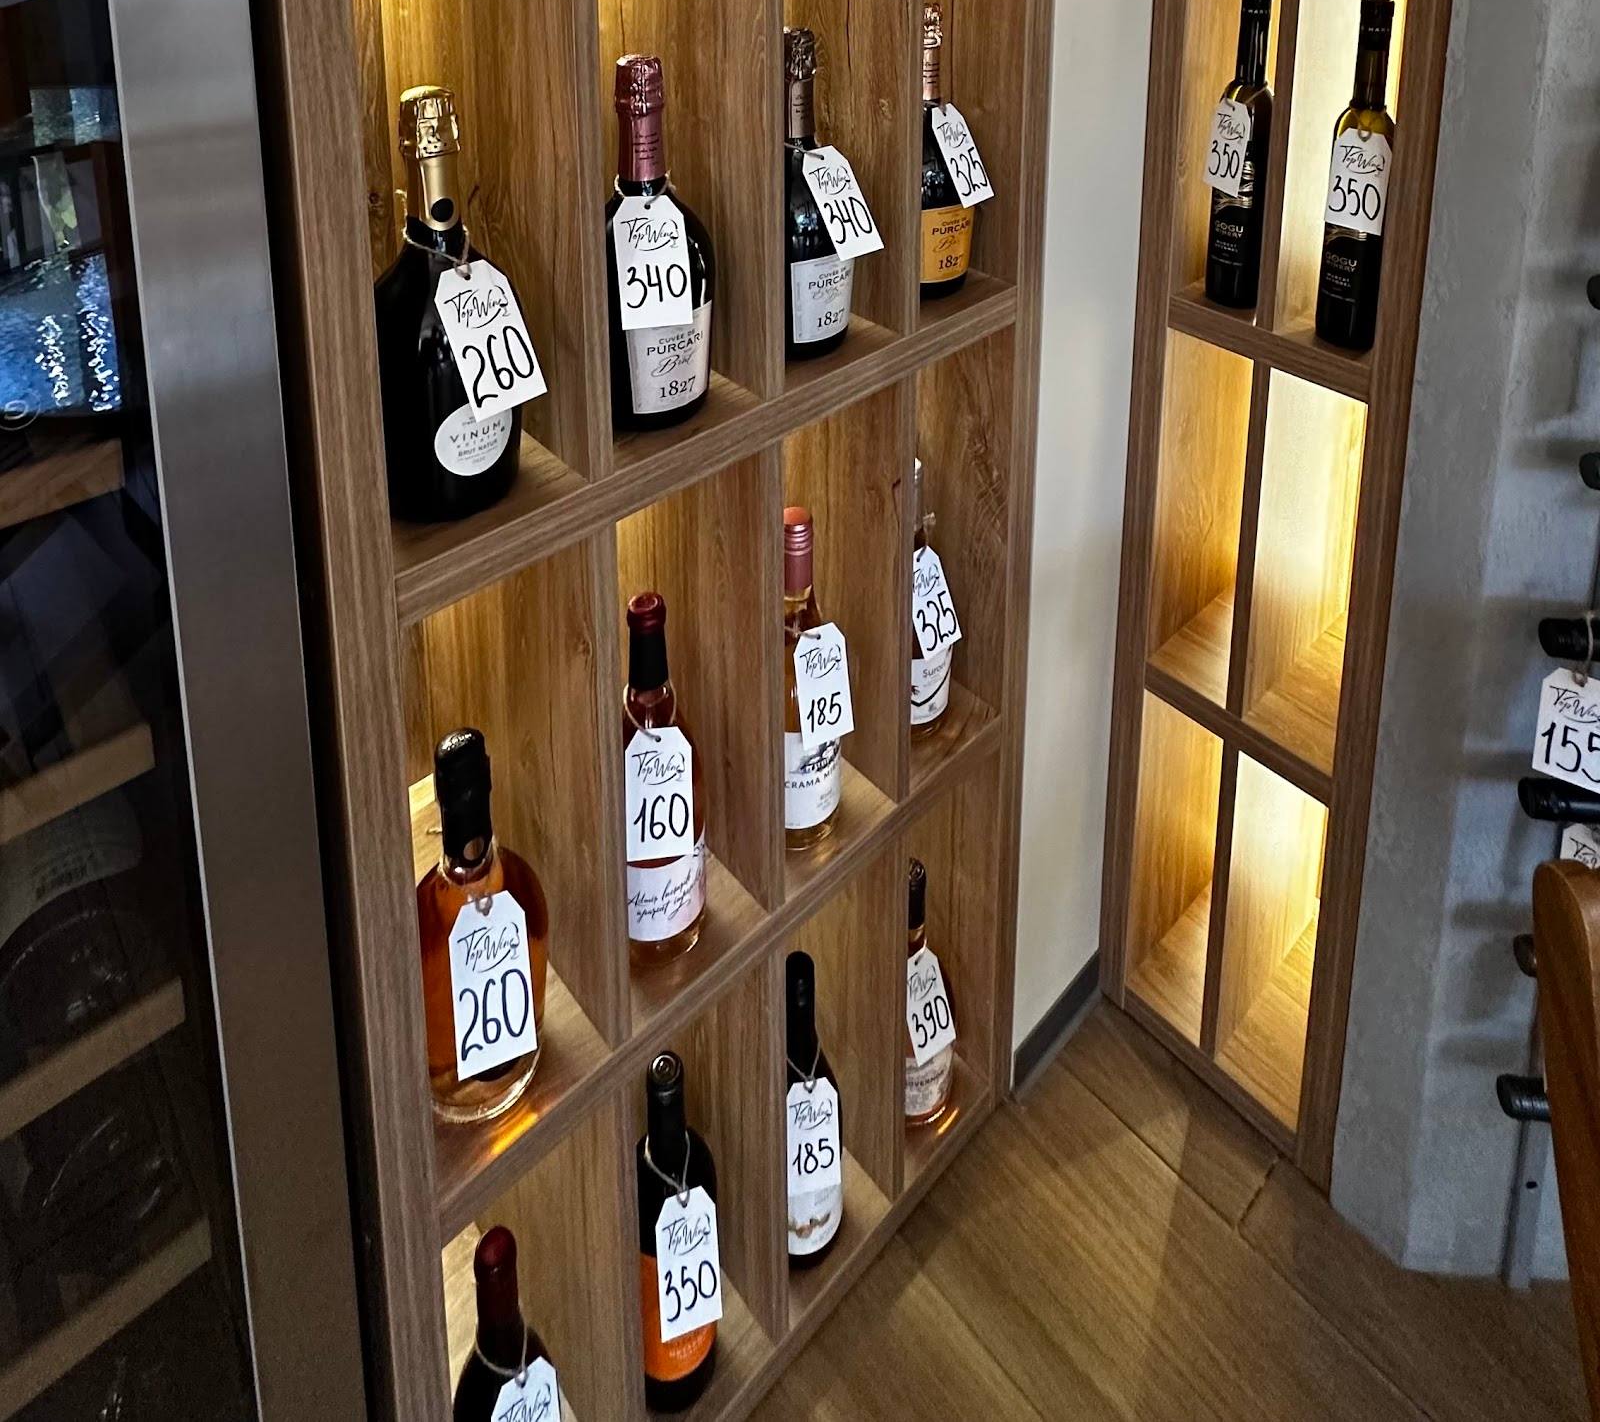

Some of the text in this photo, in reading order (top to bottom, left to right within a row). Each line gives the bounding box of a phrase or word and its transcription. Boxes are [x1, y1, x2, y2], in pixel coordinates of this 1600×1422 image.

[950, 146, 989, 196] 325
[1208, 140, 1240, 179] 350
[823, 196, 873, 245] 340
[1328, 175, 1381, 221] 350
[626, 263, 688, 309] 340
[817, 308, 845, 328] 1827
[462, 325, 534, 408] 260
[660, 375, 696, 398] 1827
[449, 419, 501, 443] VINUM
[917, 590, 957, 651] 325
[807, 691, 842, 732] 185
[1541, 721, 1600, 783] 155
[784, 777, 820, 789] CRAMA
[633, 793, 689, 842] 160
[459, 968, 530, 1061] 260
[911, 995, 950, 1048] 390
[792, 1138, 835, 1175] 185
[664, 1260, 717, 1322] 350
